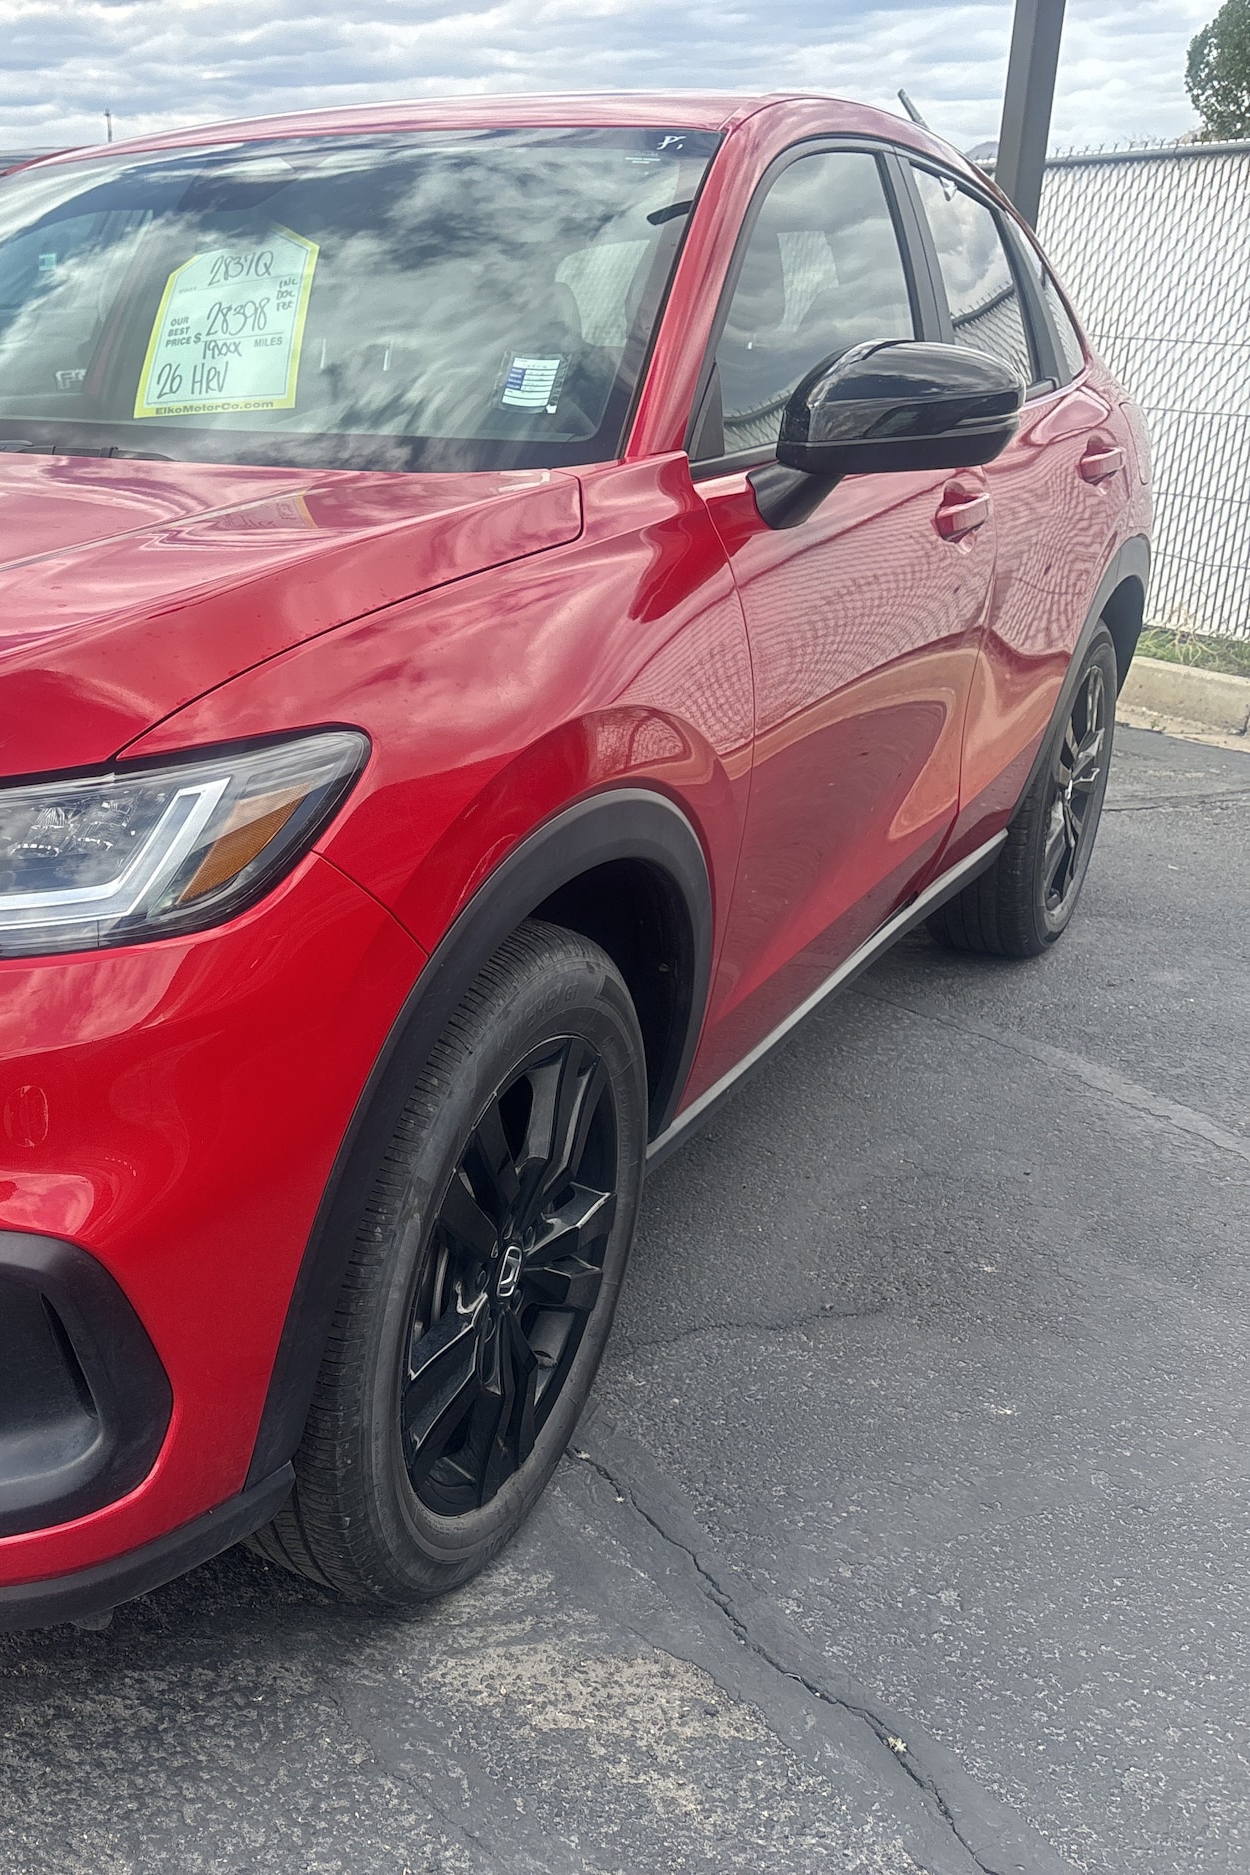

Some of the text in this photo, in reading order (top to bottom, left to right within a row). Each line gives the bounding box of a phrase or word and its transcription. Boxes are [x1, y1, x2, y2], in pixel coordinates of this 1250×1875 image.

[170, 316, 190, 327] OUR
[205, 297, 271, 337] 28398
[167, 326, 191, 338] BEST
[165, 332, 202, 348] PRICE $
[253, 336, 284, 348] MILES
[156, 362, 183, 400] 26
[155, 401, 274, 416] ElkoMotorCo.com
